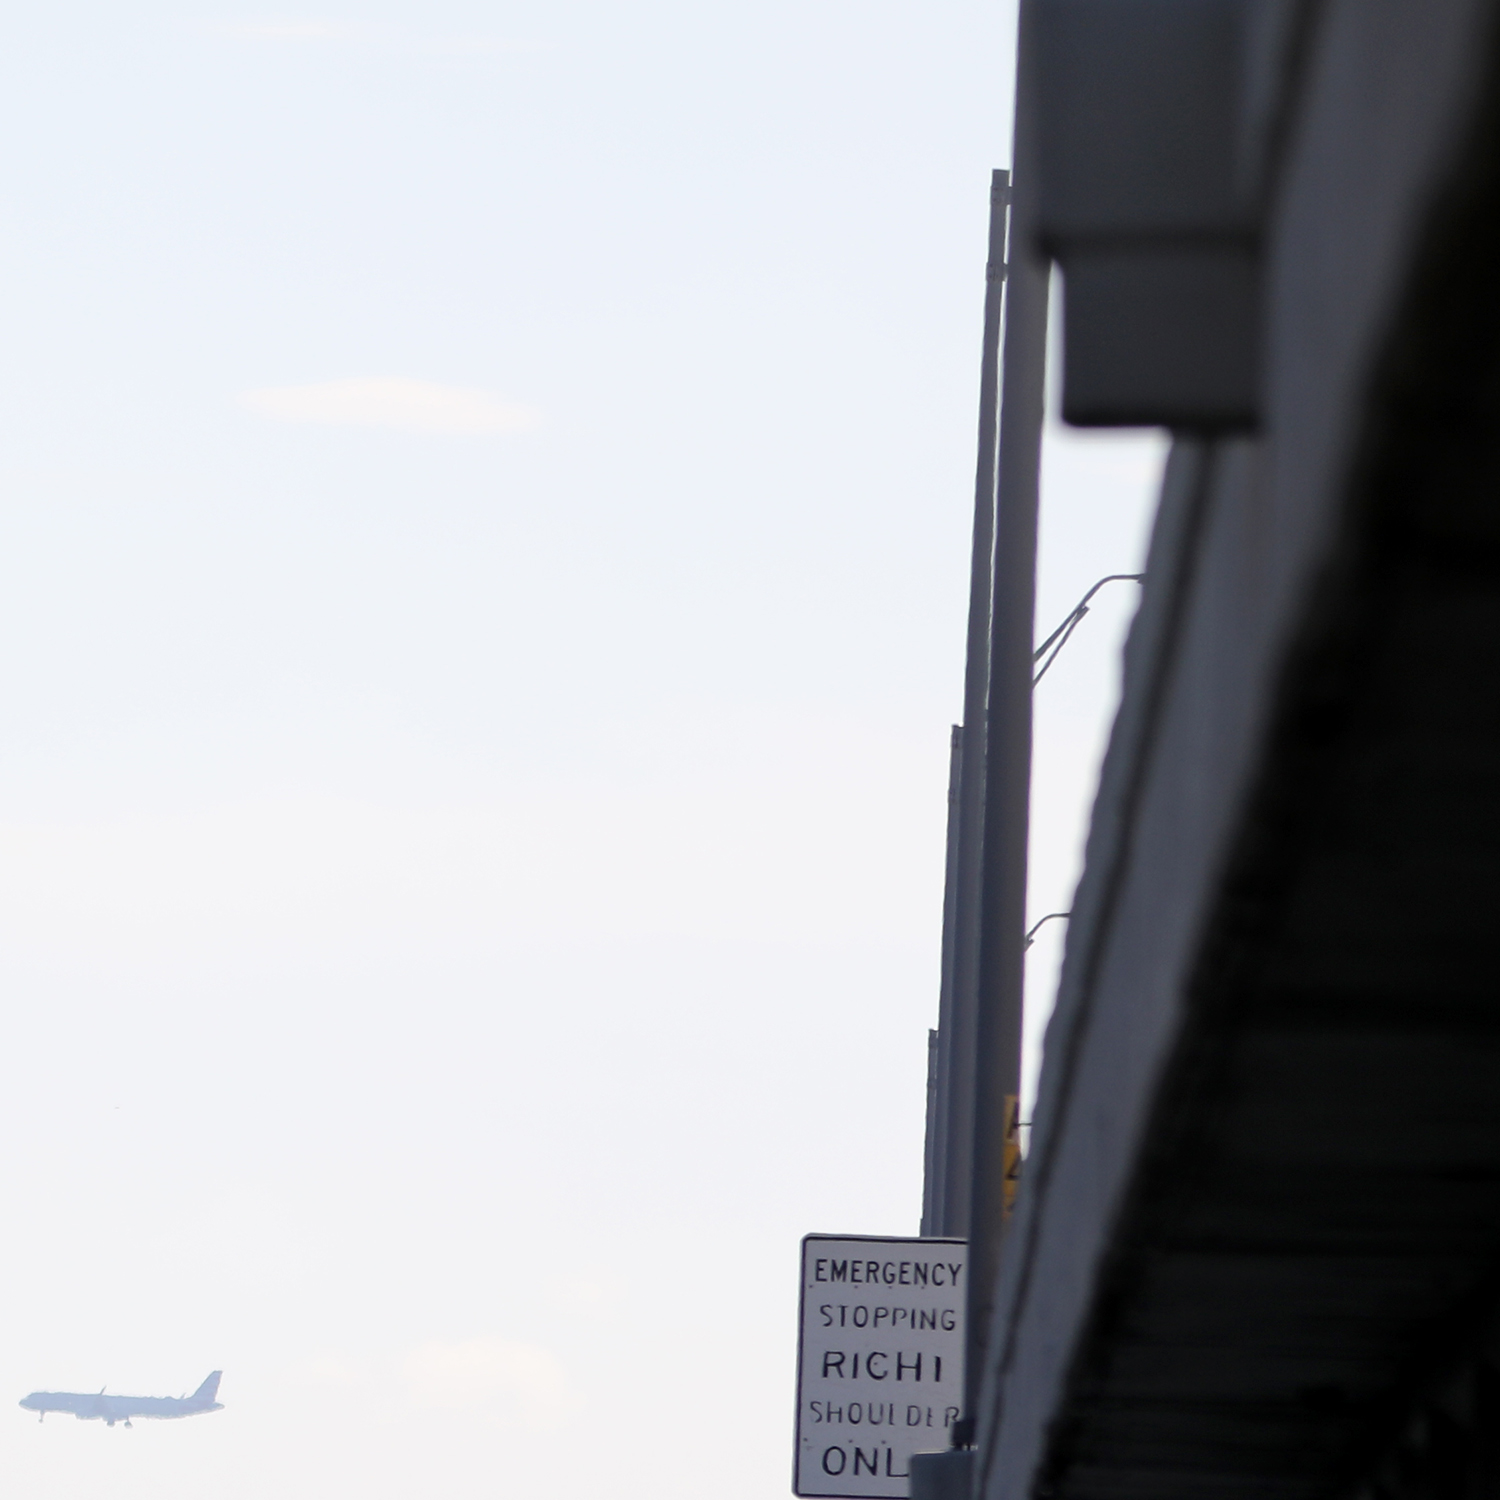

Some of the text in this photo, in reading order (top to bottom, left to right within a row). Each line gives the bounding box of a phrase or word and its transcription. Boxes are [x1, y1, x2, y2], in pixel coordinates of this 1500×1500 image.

[815, 1259, 962, 1286] EMERGENCY
[819, 1305, 955, 1331] STOPPING
[822, 1446, 909, 1477] ONL
